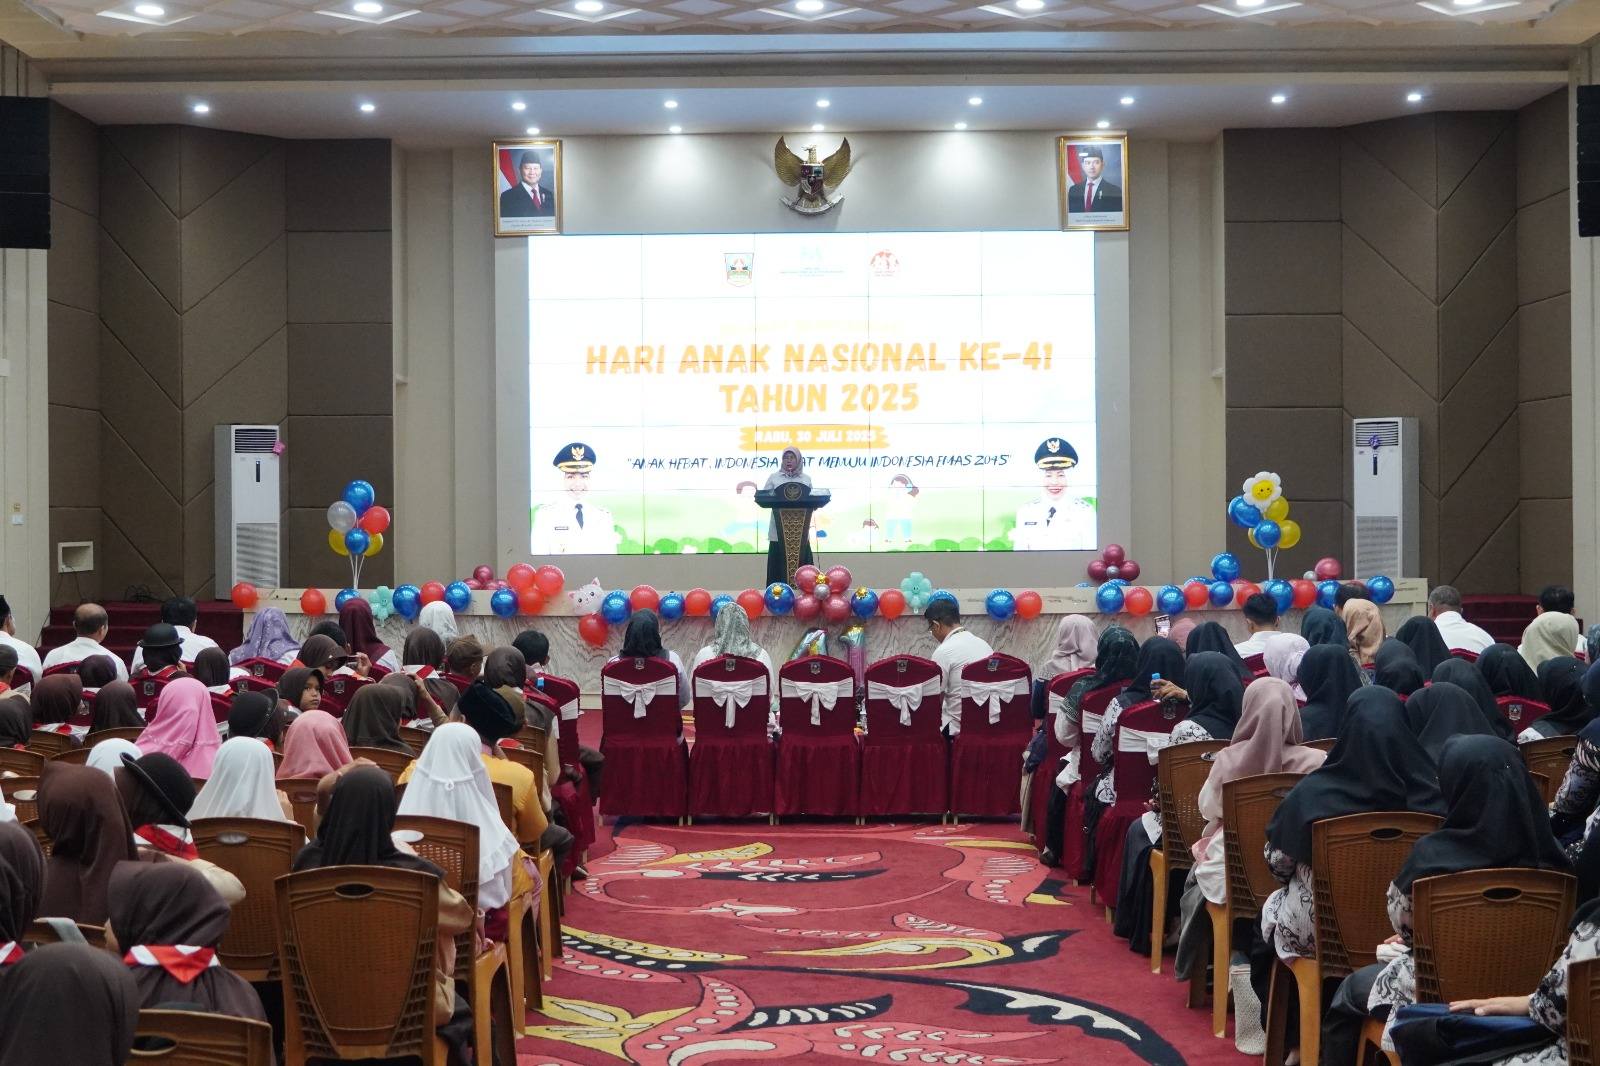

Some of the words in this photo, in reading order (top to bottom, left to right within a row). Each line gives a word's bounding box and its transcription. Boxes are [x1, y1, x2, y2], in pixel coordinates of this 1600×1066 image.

[587, 346, 664, 373] HARI
[679, 345, 770, 373] ANAK
[783, 343, 945, 372] NASIONAL
[958, 342, 1053, 370] KE-41
[720, 383, 827, 412] TAHUN
[841, 383, 918, 412] 2025
[816, 430, 842, 443] JULI
[870, 455, 934, 469] INDONESIA
[936, 455, 972, 468] EMAS
